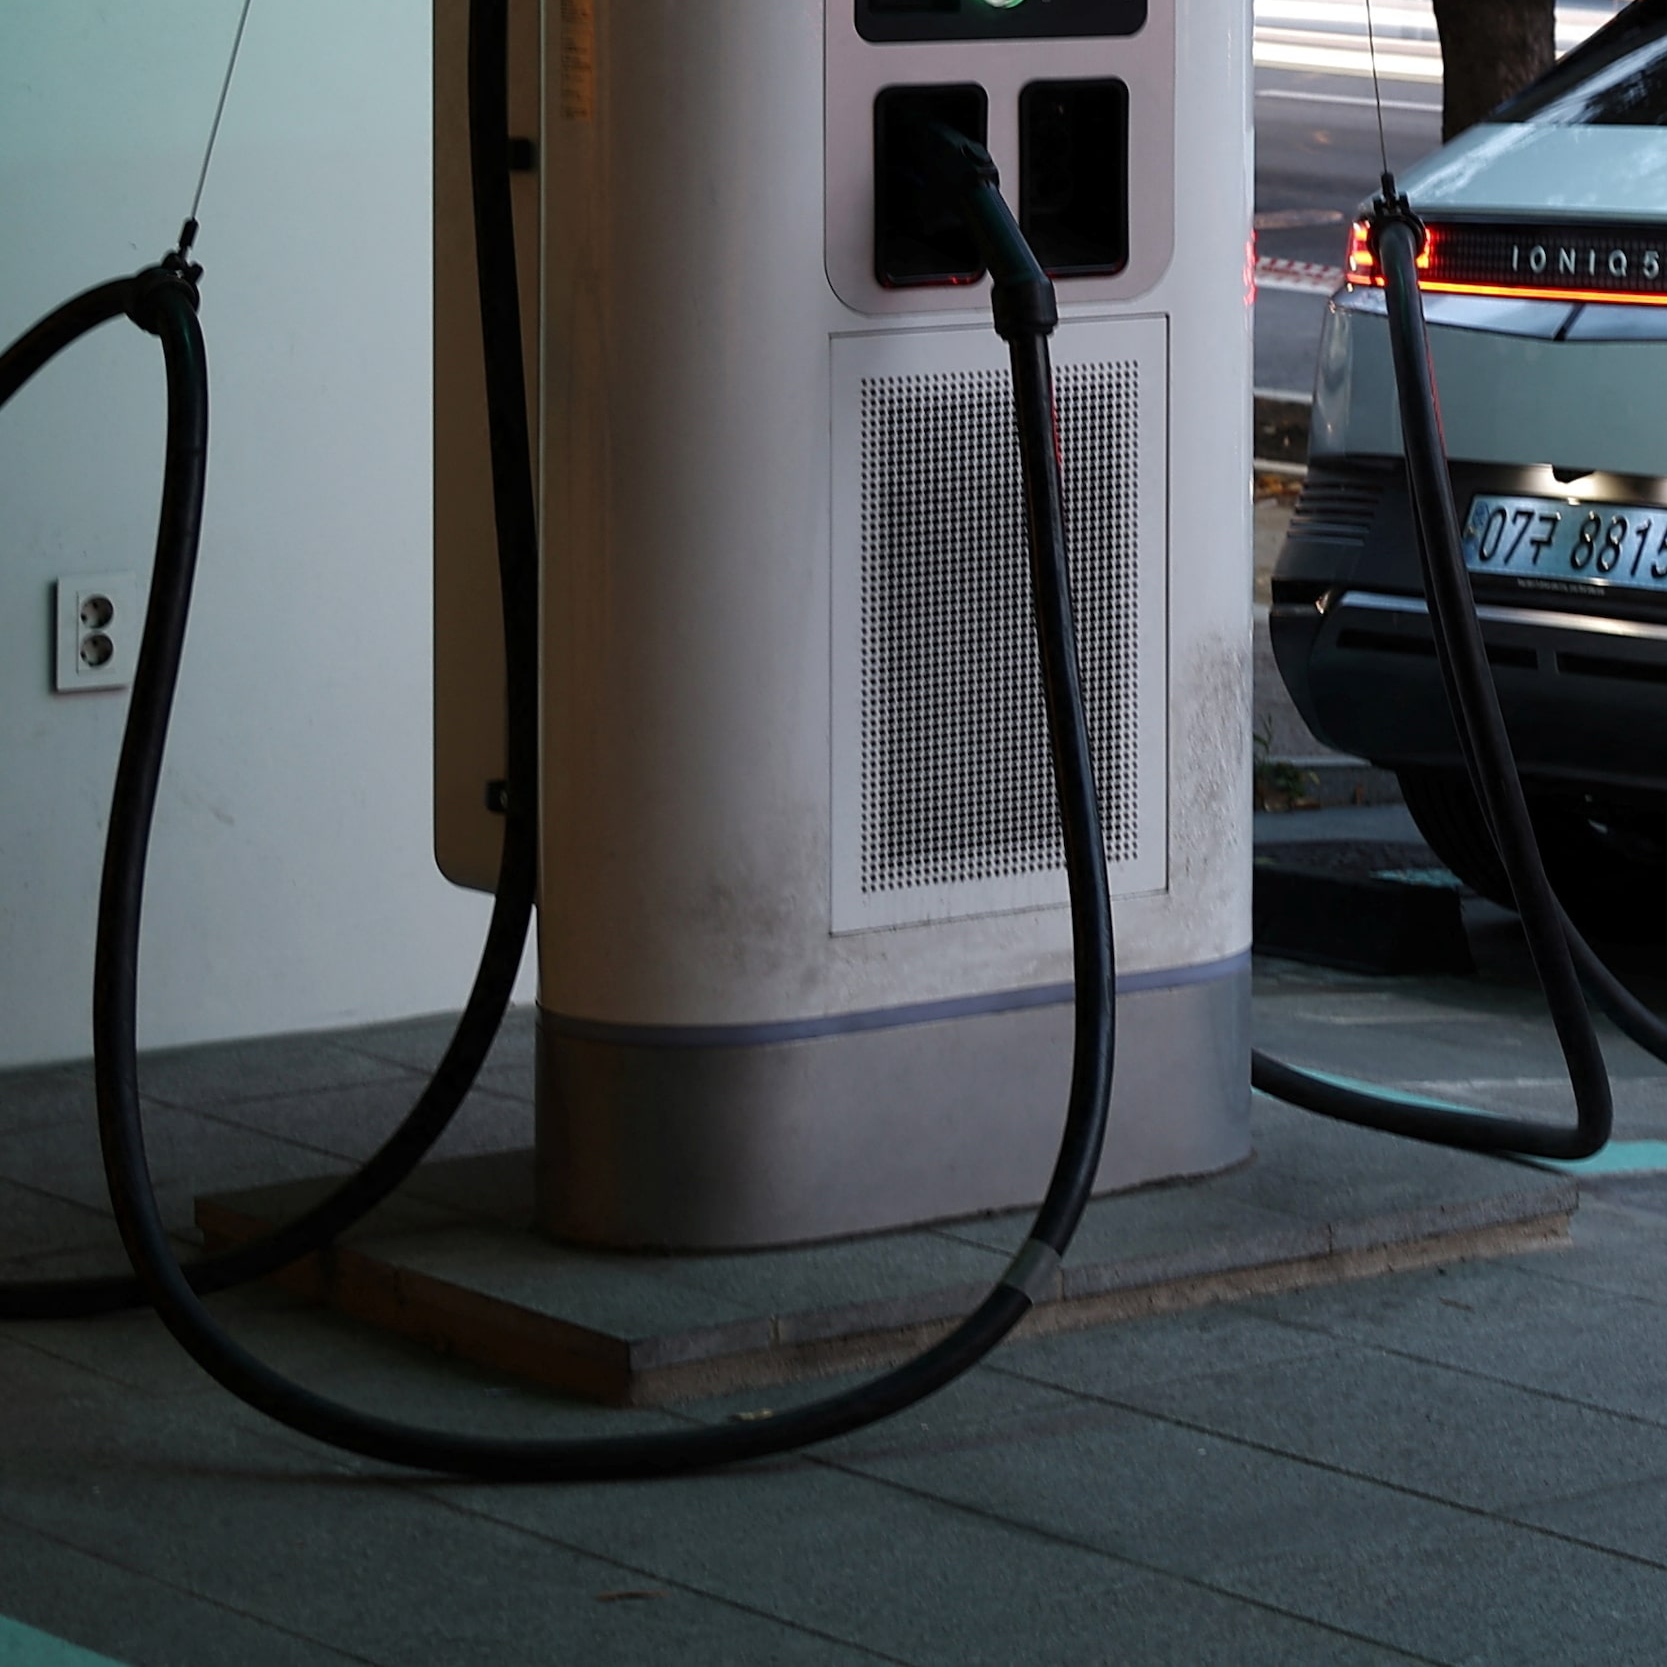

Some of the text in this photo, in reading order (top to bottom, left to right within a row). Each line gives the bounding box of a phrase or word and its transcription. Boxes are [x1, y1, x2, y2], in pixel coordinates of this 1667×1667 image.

[1511, 244, 1660, 280] IONIQ 5
[1478, 504, 1561, 566] 07구
